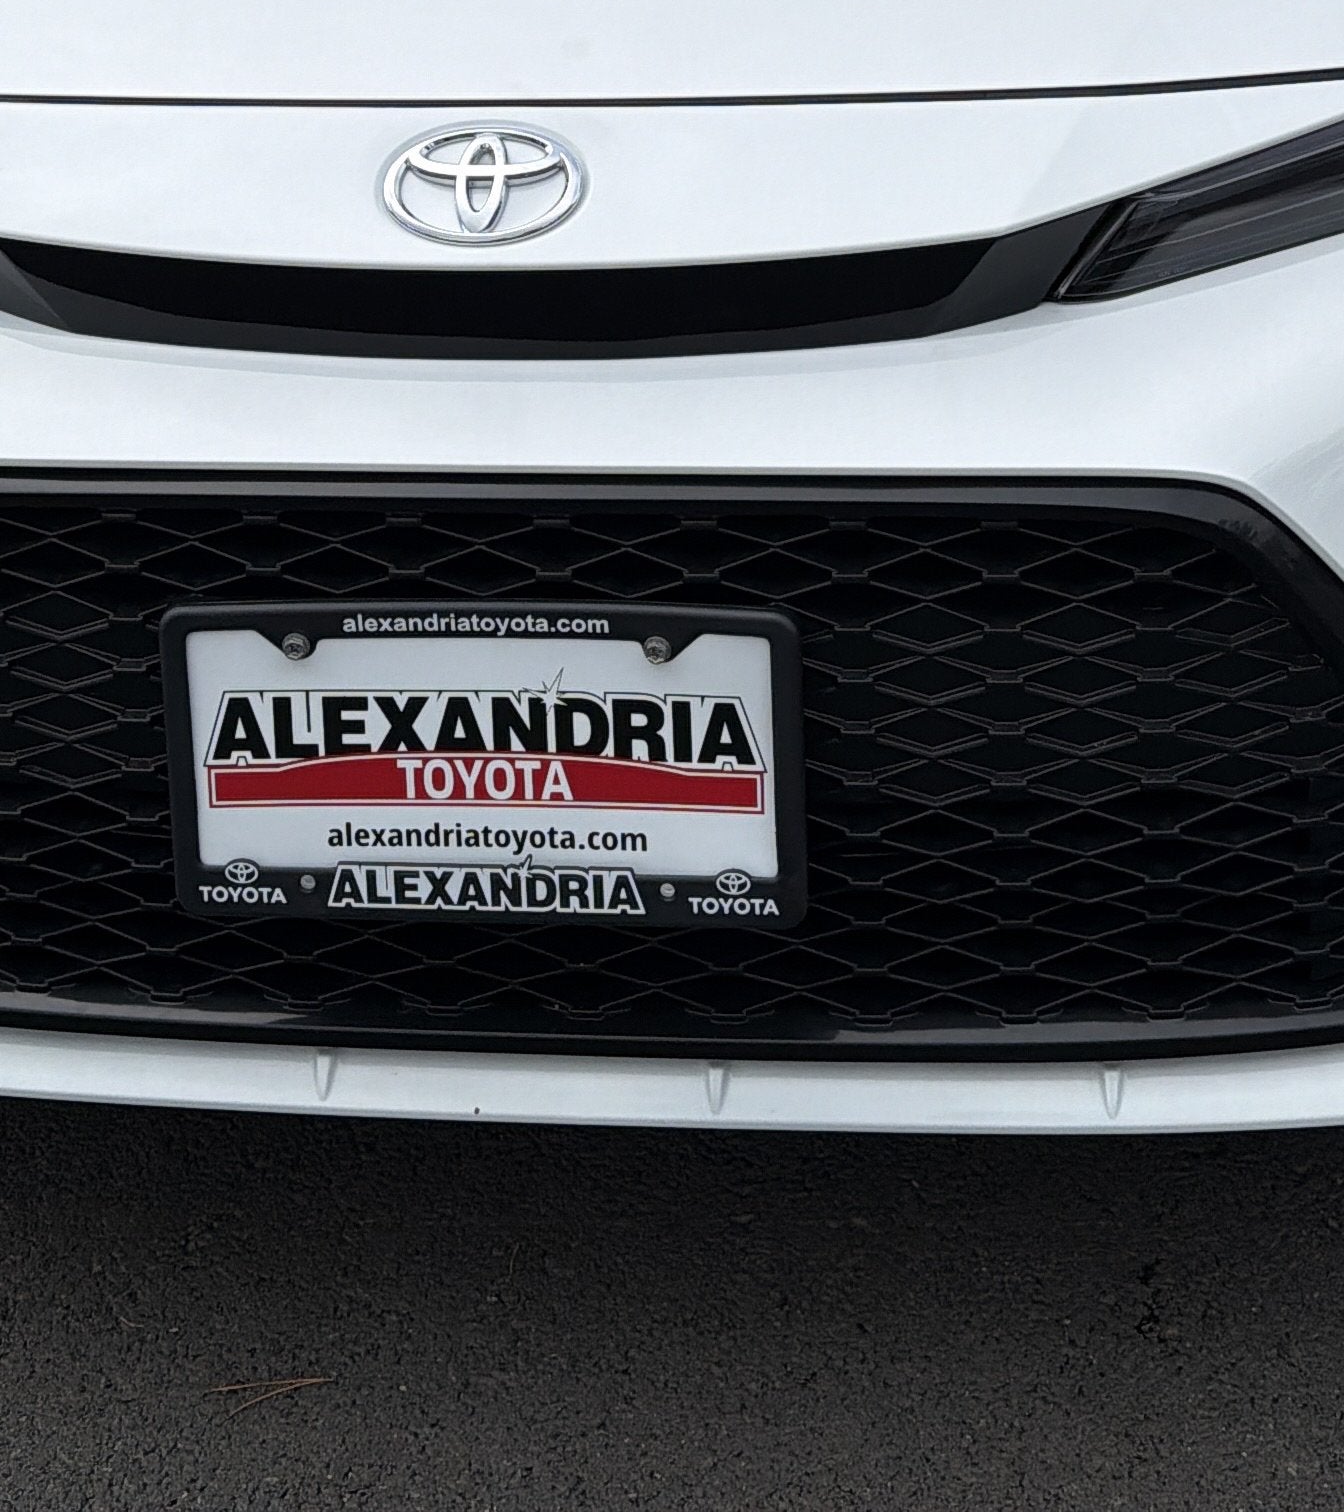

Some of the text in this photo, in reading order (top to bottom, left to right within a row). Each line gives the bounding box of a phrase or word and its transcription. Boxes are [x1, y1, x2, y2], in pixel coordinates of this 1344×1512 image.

[342, 613, 611, 637] alexandriatoyota.com
[207, 691, 764, 768] ALEXANDRIA
[396, 758, 574, 801] TOYOTA
[327, 822, 648, 856] alexandriatoyota.com
[198, 885, 288, 904] TOYOTA
[329, 864, 645, 915] ALEXANDRIA
[687, 896, 780, 917] TOYOTA
